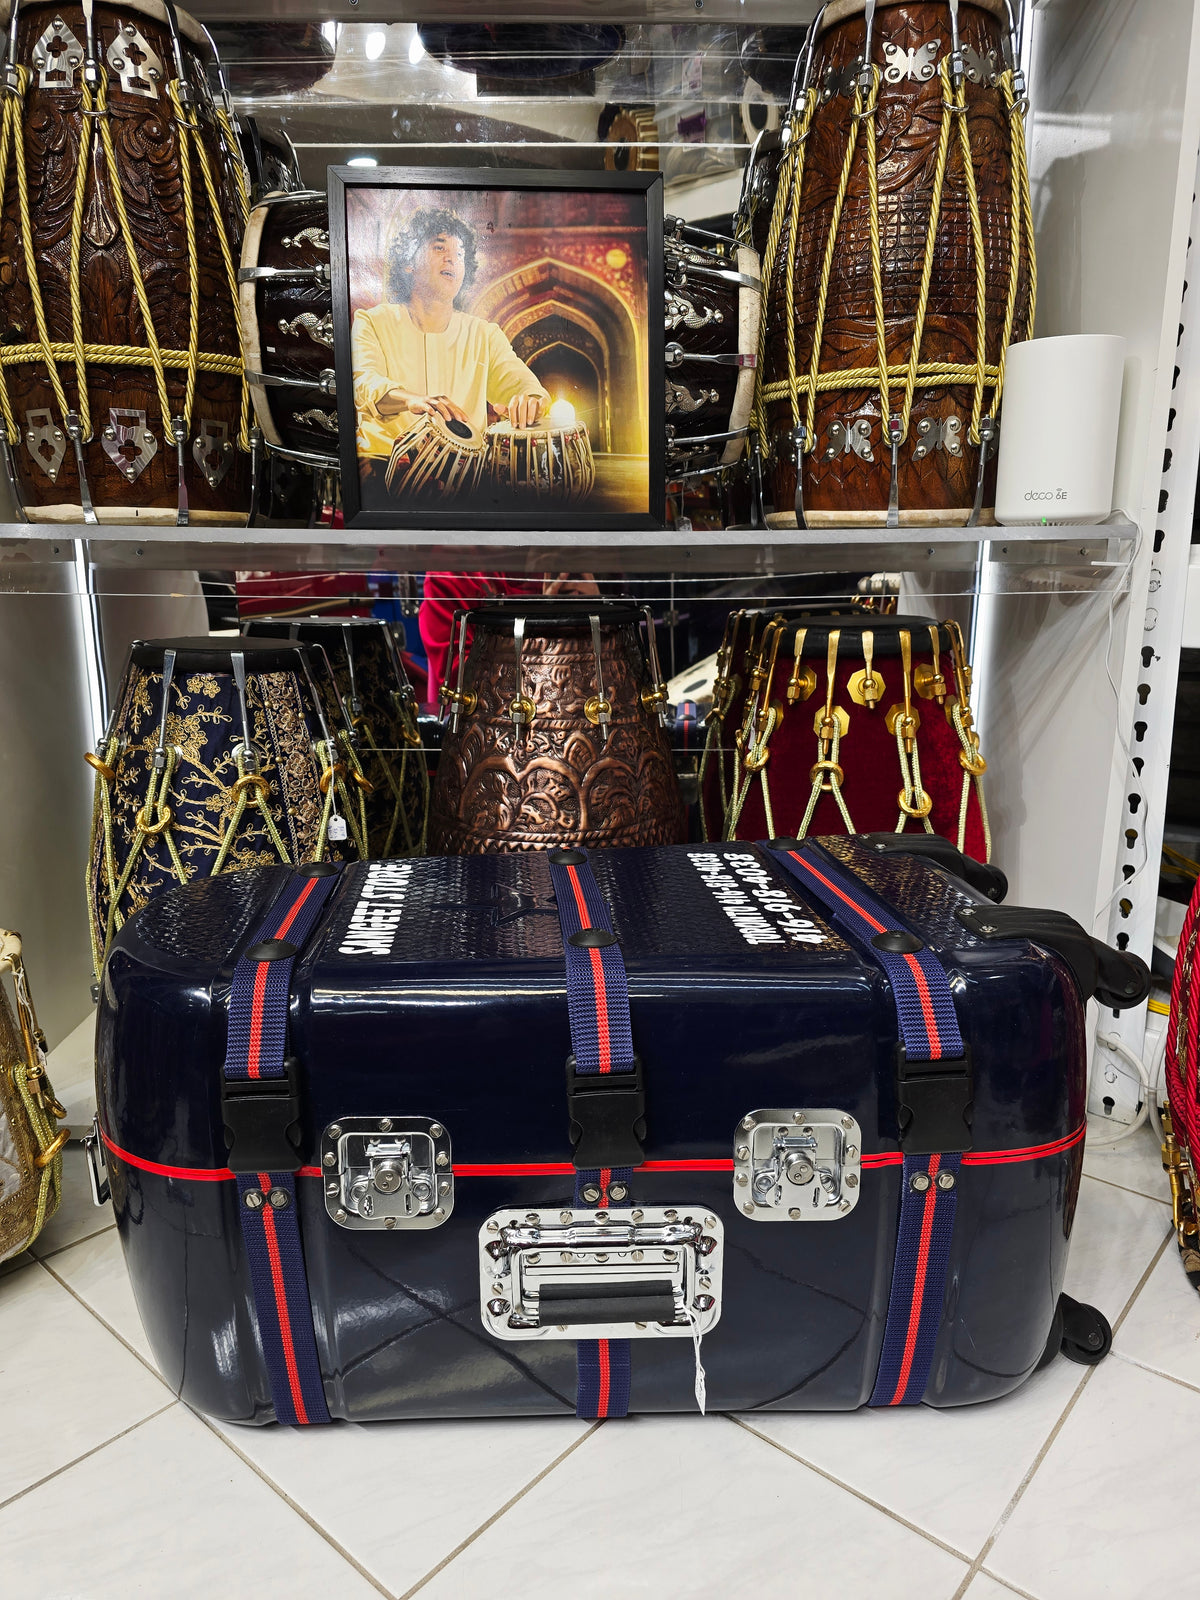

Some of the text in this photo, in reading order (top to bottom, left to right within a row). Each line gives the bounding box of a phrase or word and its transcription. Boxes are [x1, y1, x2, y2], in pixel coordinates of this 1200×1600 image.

[1024, 490, 1068, 501] deco 6E
[338, 864, 414, 955] SANGEET STORE
[722, 905, 786, 945] TORONTO
[723, 852, 829, 944] 416-918-4038
